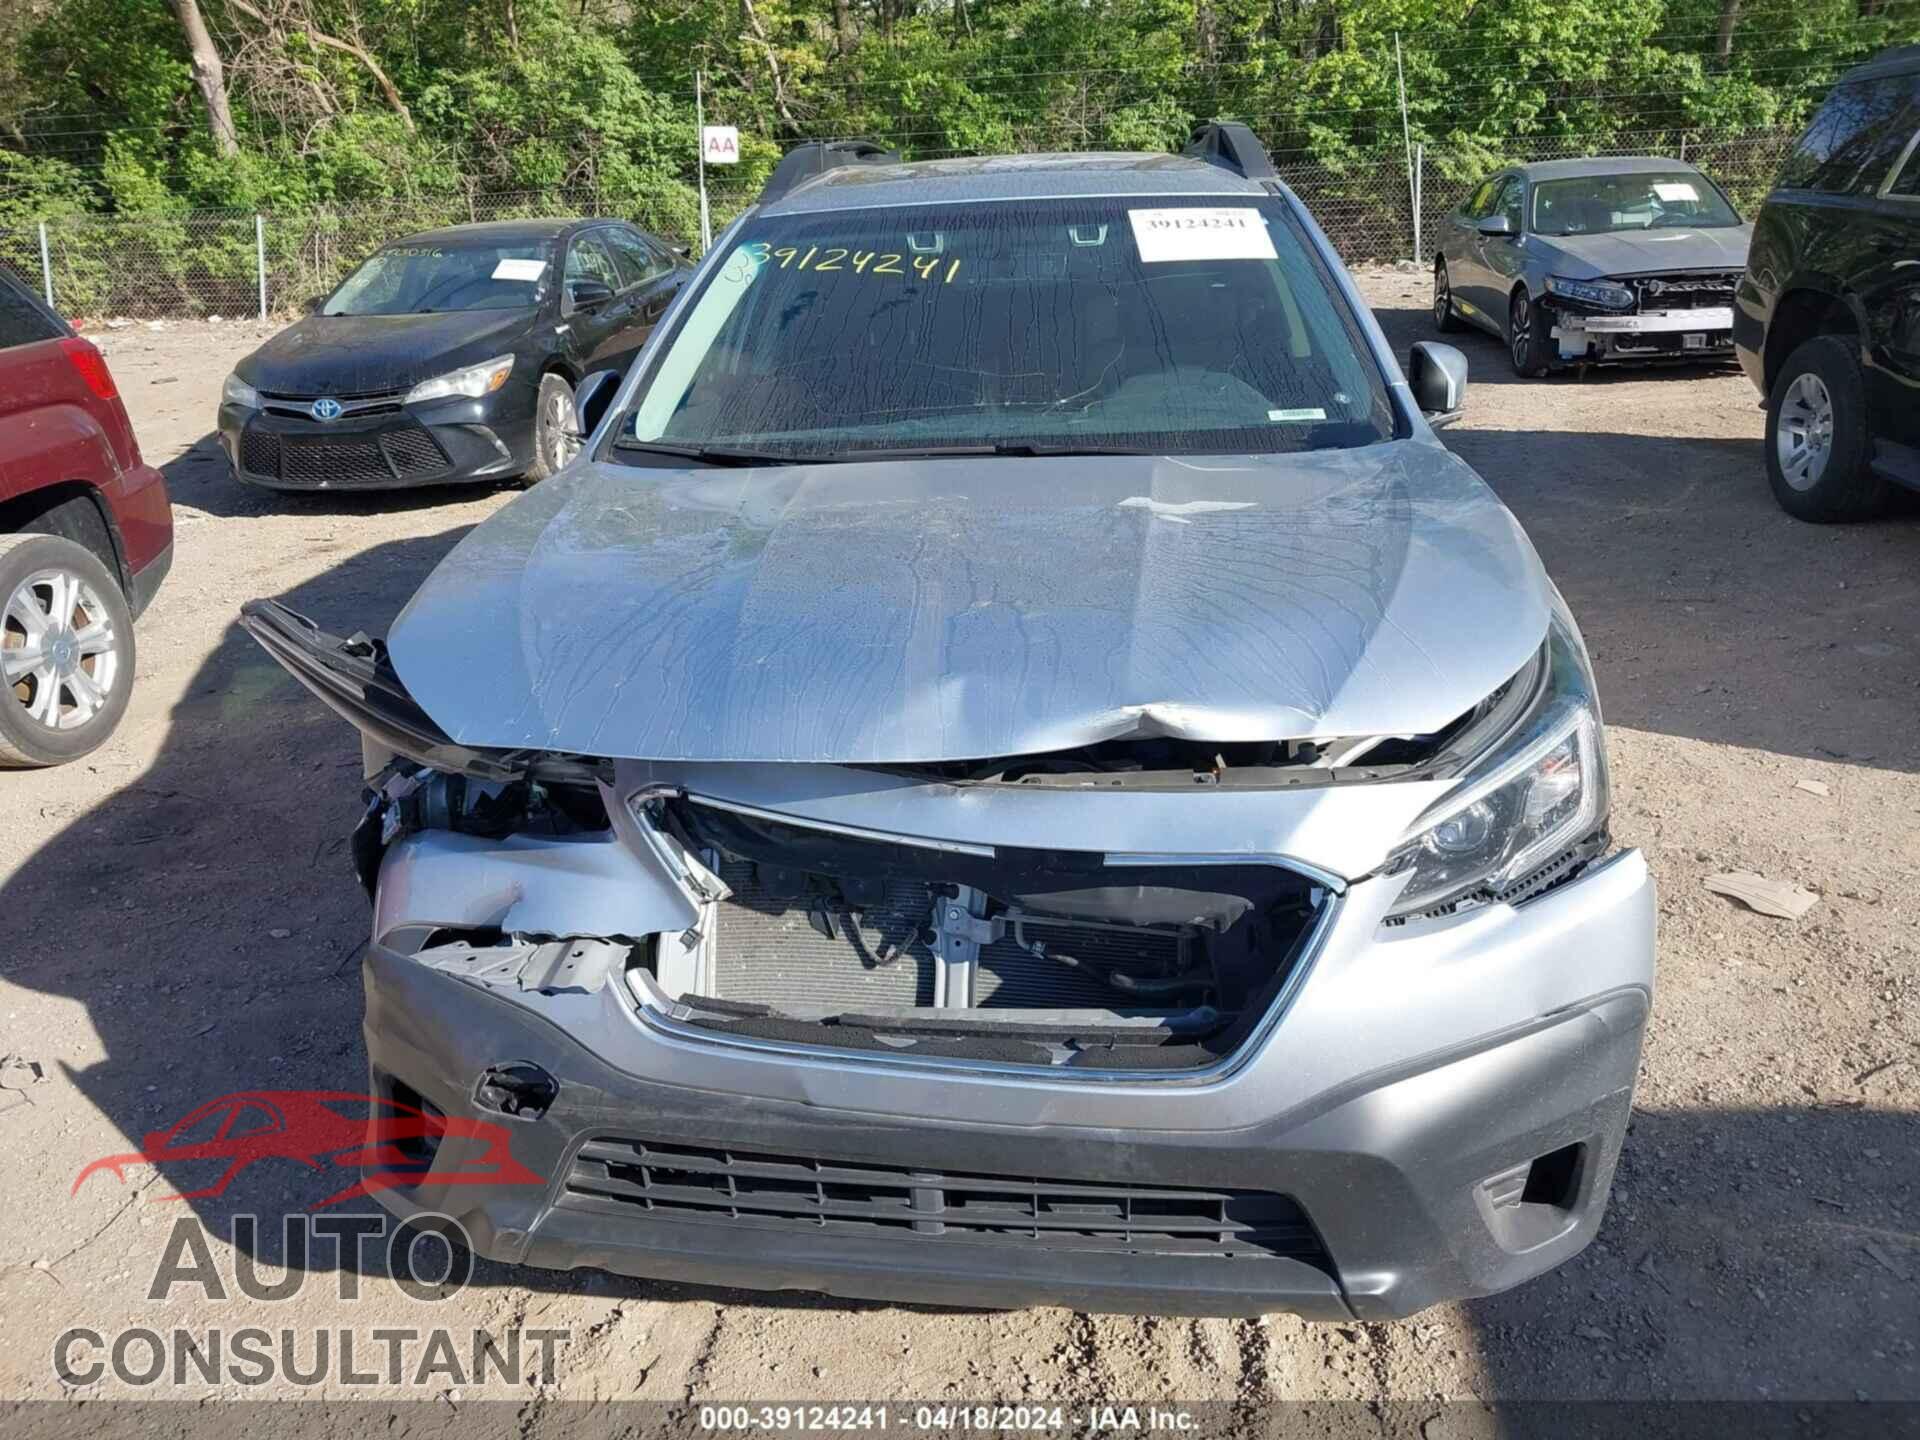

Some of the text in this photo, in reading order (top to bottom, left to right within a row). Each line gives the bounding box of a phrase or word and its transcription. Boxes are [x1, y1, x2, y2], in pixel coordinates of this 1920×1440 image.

[708, 136, 736, 153] AA
[1146, 217, 1248, 231] 39124241
[750, 242, 961, 283] 39124241
